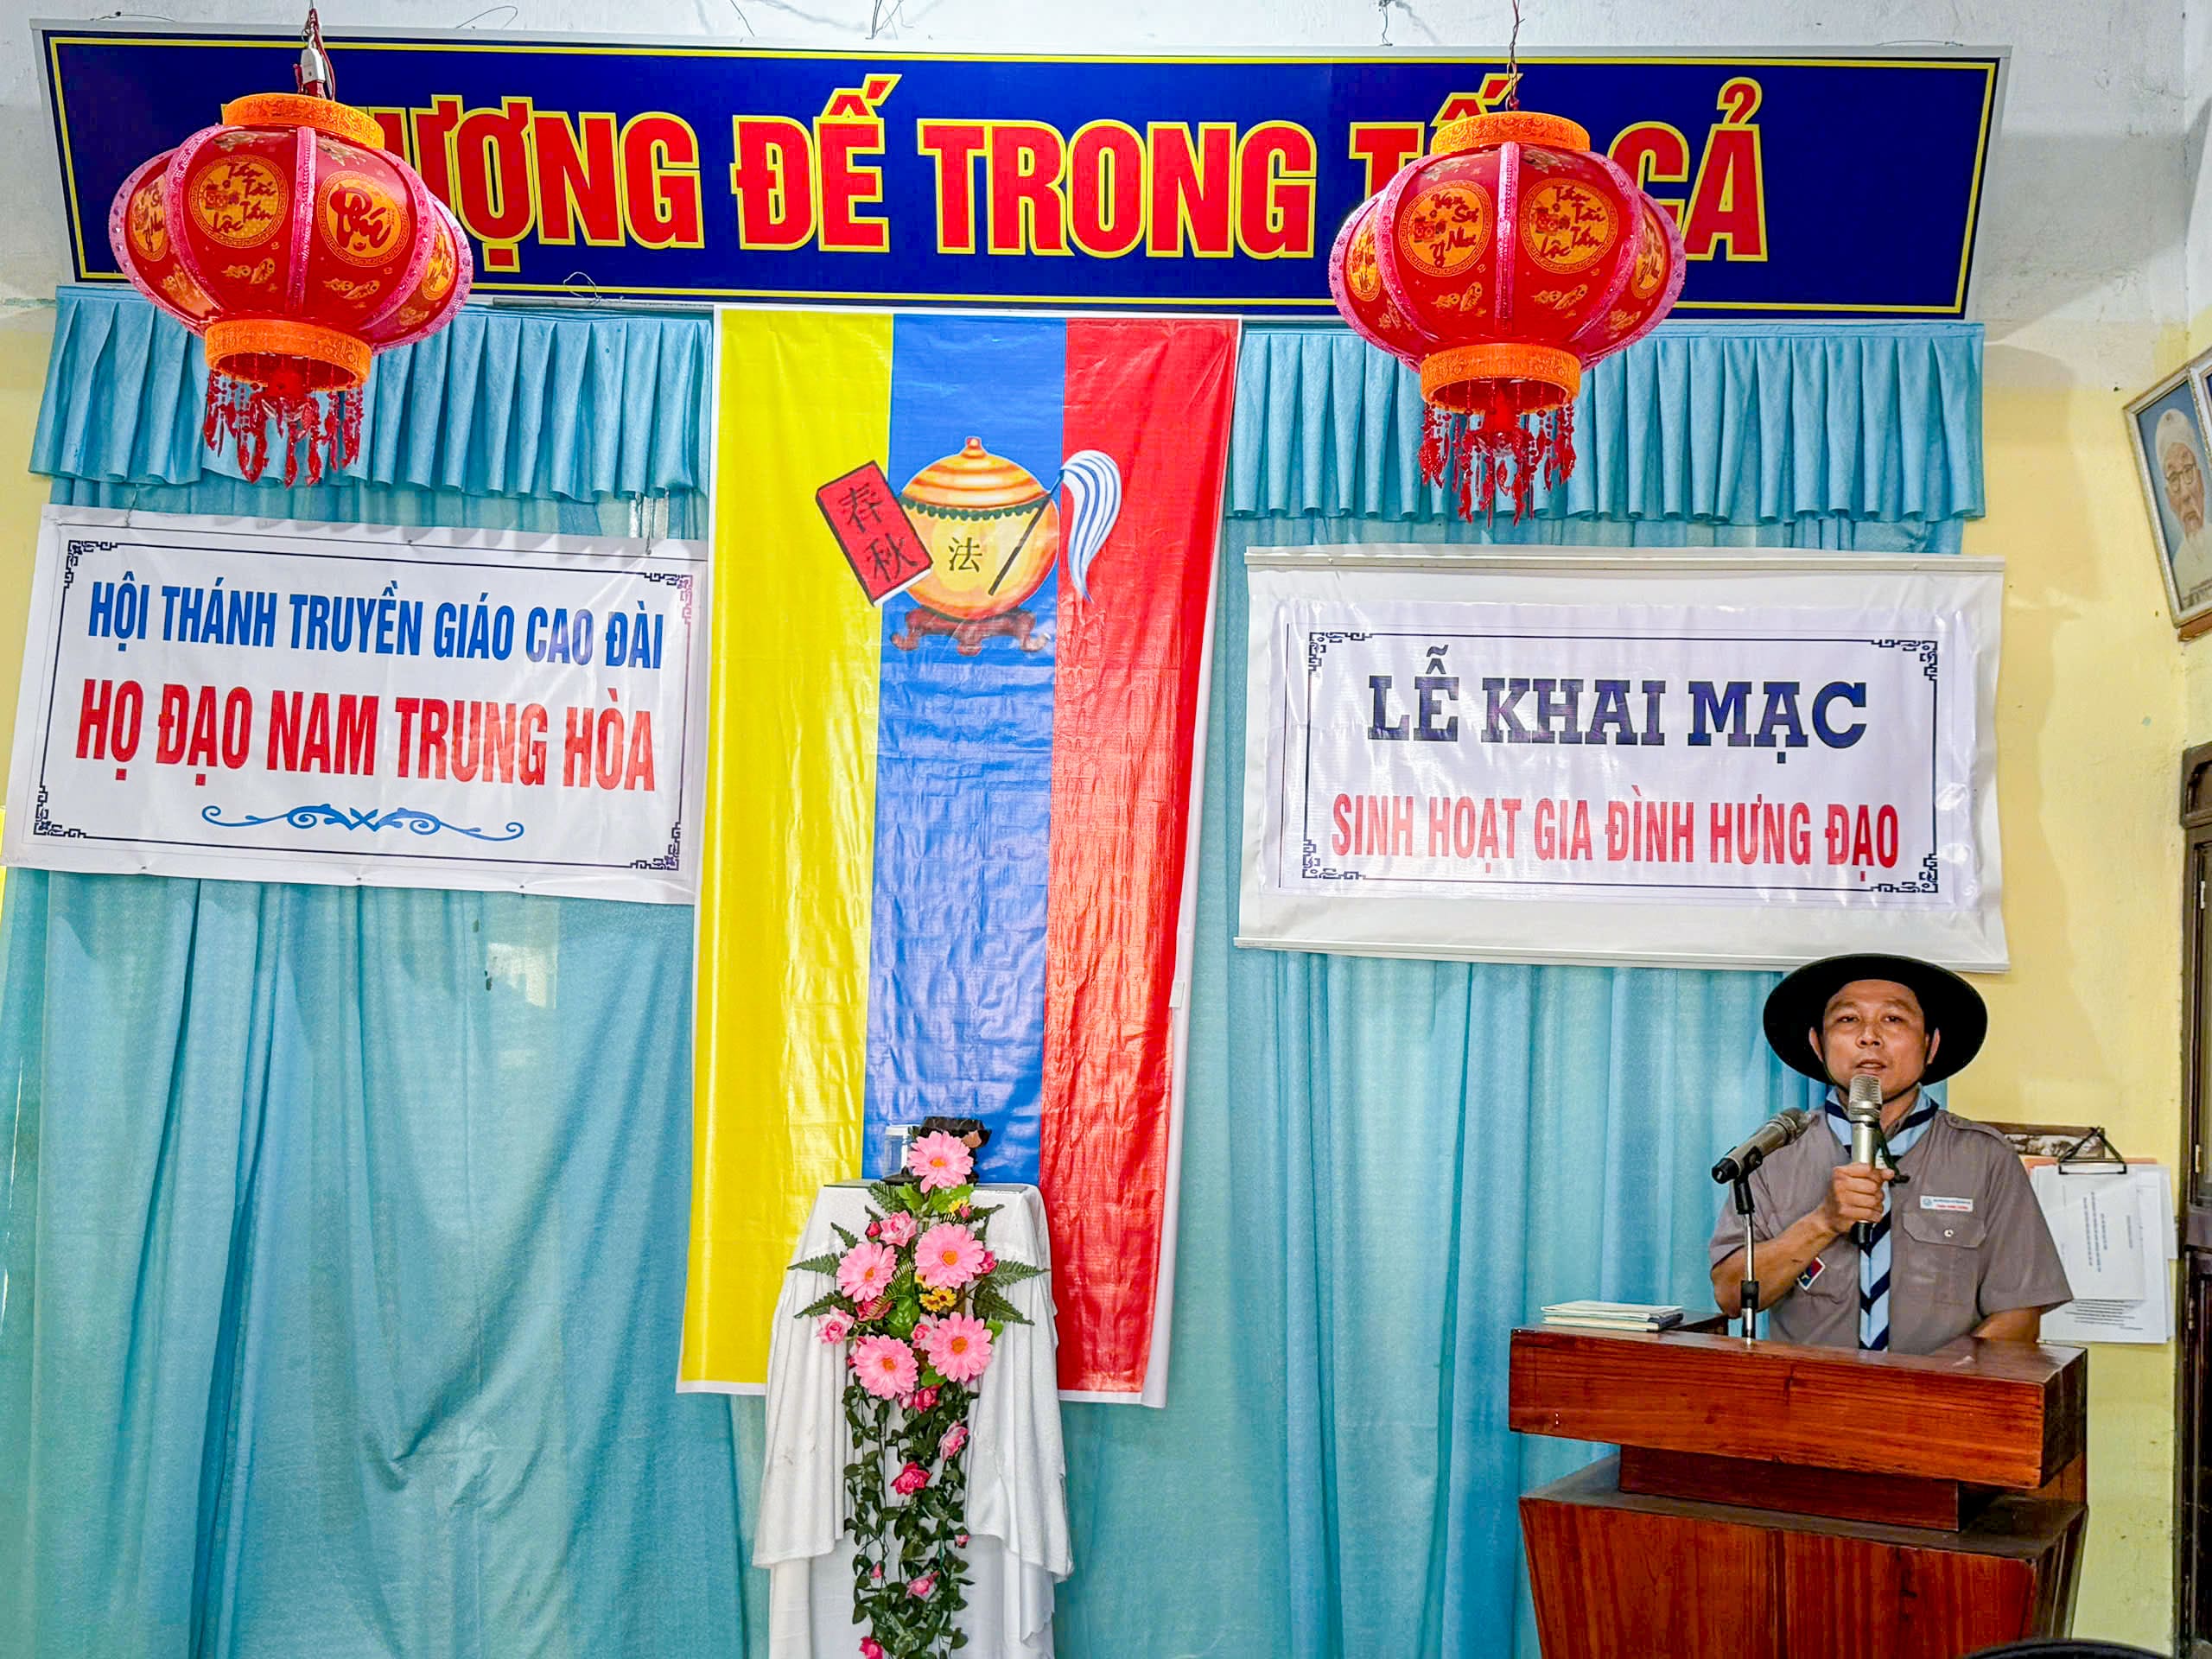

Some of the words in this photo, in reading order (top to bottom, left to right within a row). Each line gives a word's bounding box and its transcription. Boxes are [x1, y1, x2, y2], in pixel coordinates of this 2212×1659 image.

[221, 94, 705, 272] ƯỢNG
[731, 73, 902, 252] ĐẾ
[917, 119, 1318, 260] TRONG
[947, 536, 983, 574] 法
[88, 570, 149, 652] HỘI
[161, 576, 277, 648] THÁNH
[289, 580, 423, 656] TRUYỀN
[434, 592, 515, 661] GIÁO
[525, 607, 594, 666] CAO
[605, 600, 664, 670] ĐÀI
[75, 677, 143, 780] HỌ
[156, 683, 253, 786] ĐẠO
[266, 690, 380, 776] NAM
[394, 696, 549, 786] TRUNG
[563, 687, 655, 791] HÒA
[1367, 645, 1459, 742] LỄ
[1480, 677, 1663, 746] KHAI
[1687, 680, 1867, 765] MẠC
[1332, 793, 1414, 857] SINH
[1428, 796, 1522, 874] HOẠT
[1534, 798, 1592, 861] GIA
[1605, 785, 1694, 864] ĐÌNH
[1710, 793, 1811, 867] HƯNG
[1824, 804, 1900, 882] ĐẠO
